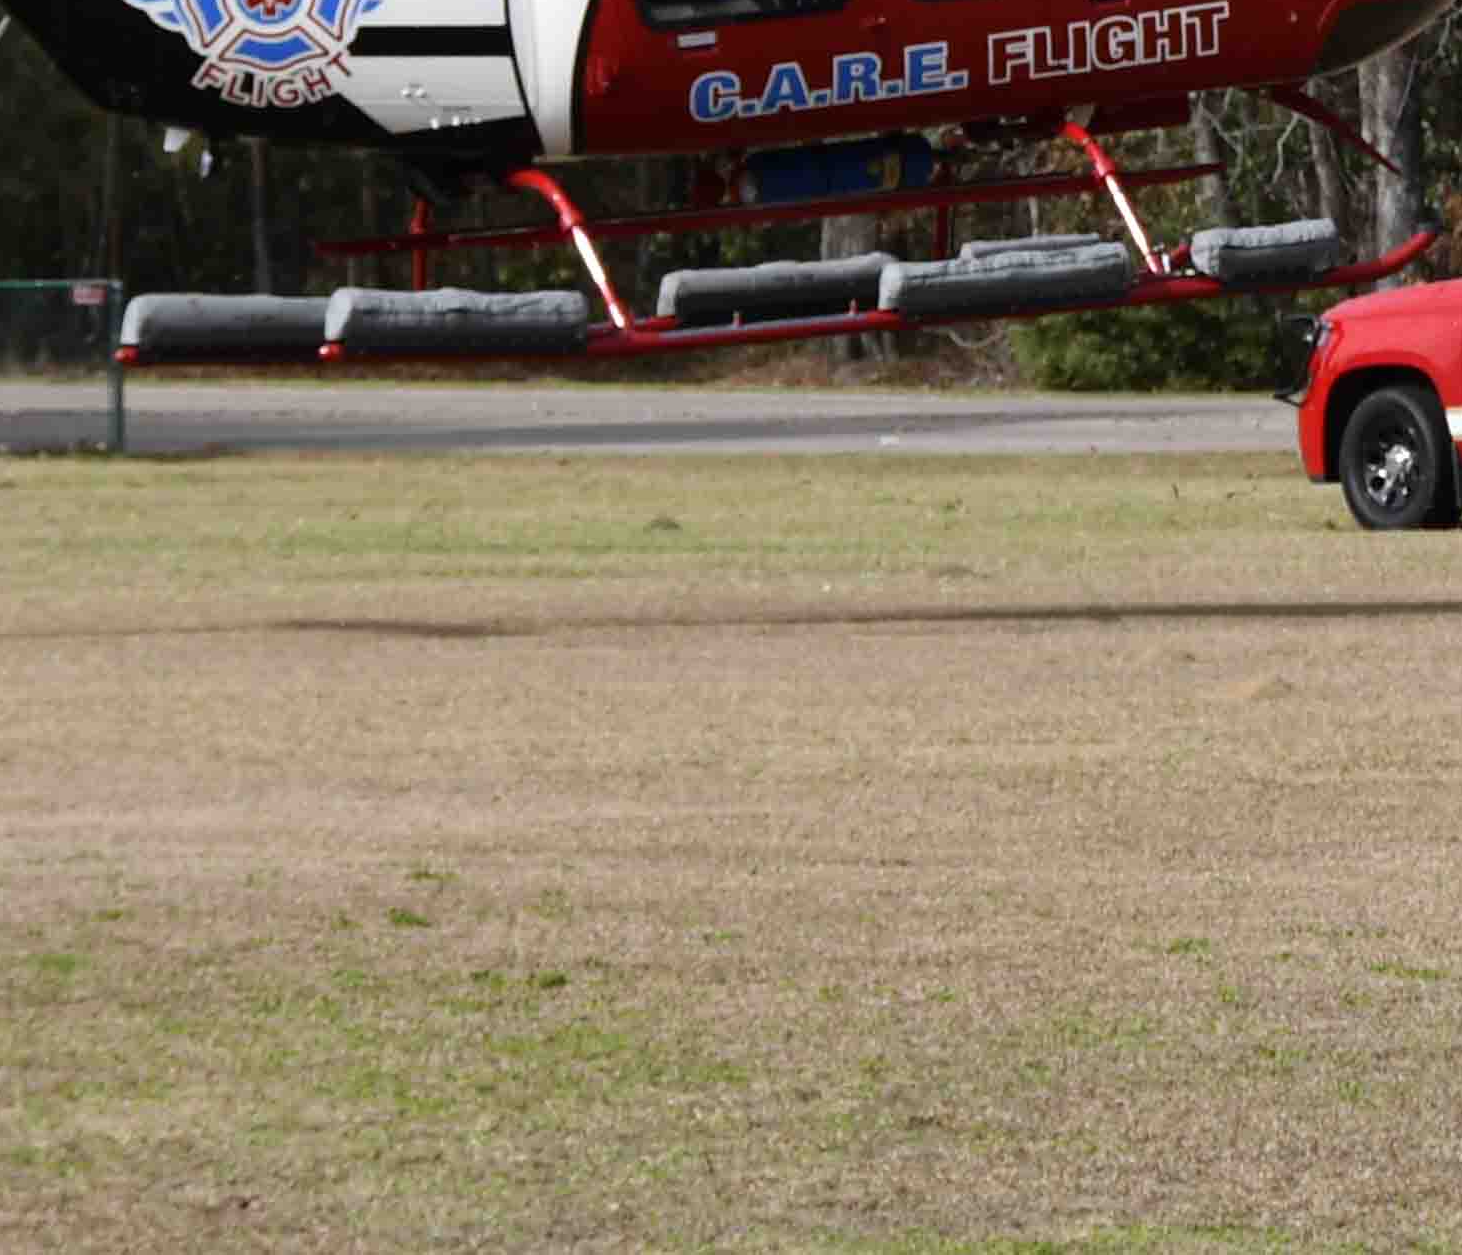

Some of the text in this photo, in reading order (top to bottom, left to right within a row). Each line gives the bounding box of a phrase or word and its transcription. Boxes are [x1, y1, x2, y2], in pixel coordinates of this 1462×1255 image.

[192, 51, 352, 107] FLIGHT
[690, 0, 1230, 122] C.A.R.E. FLIGHT
